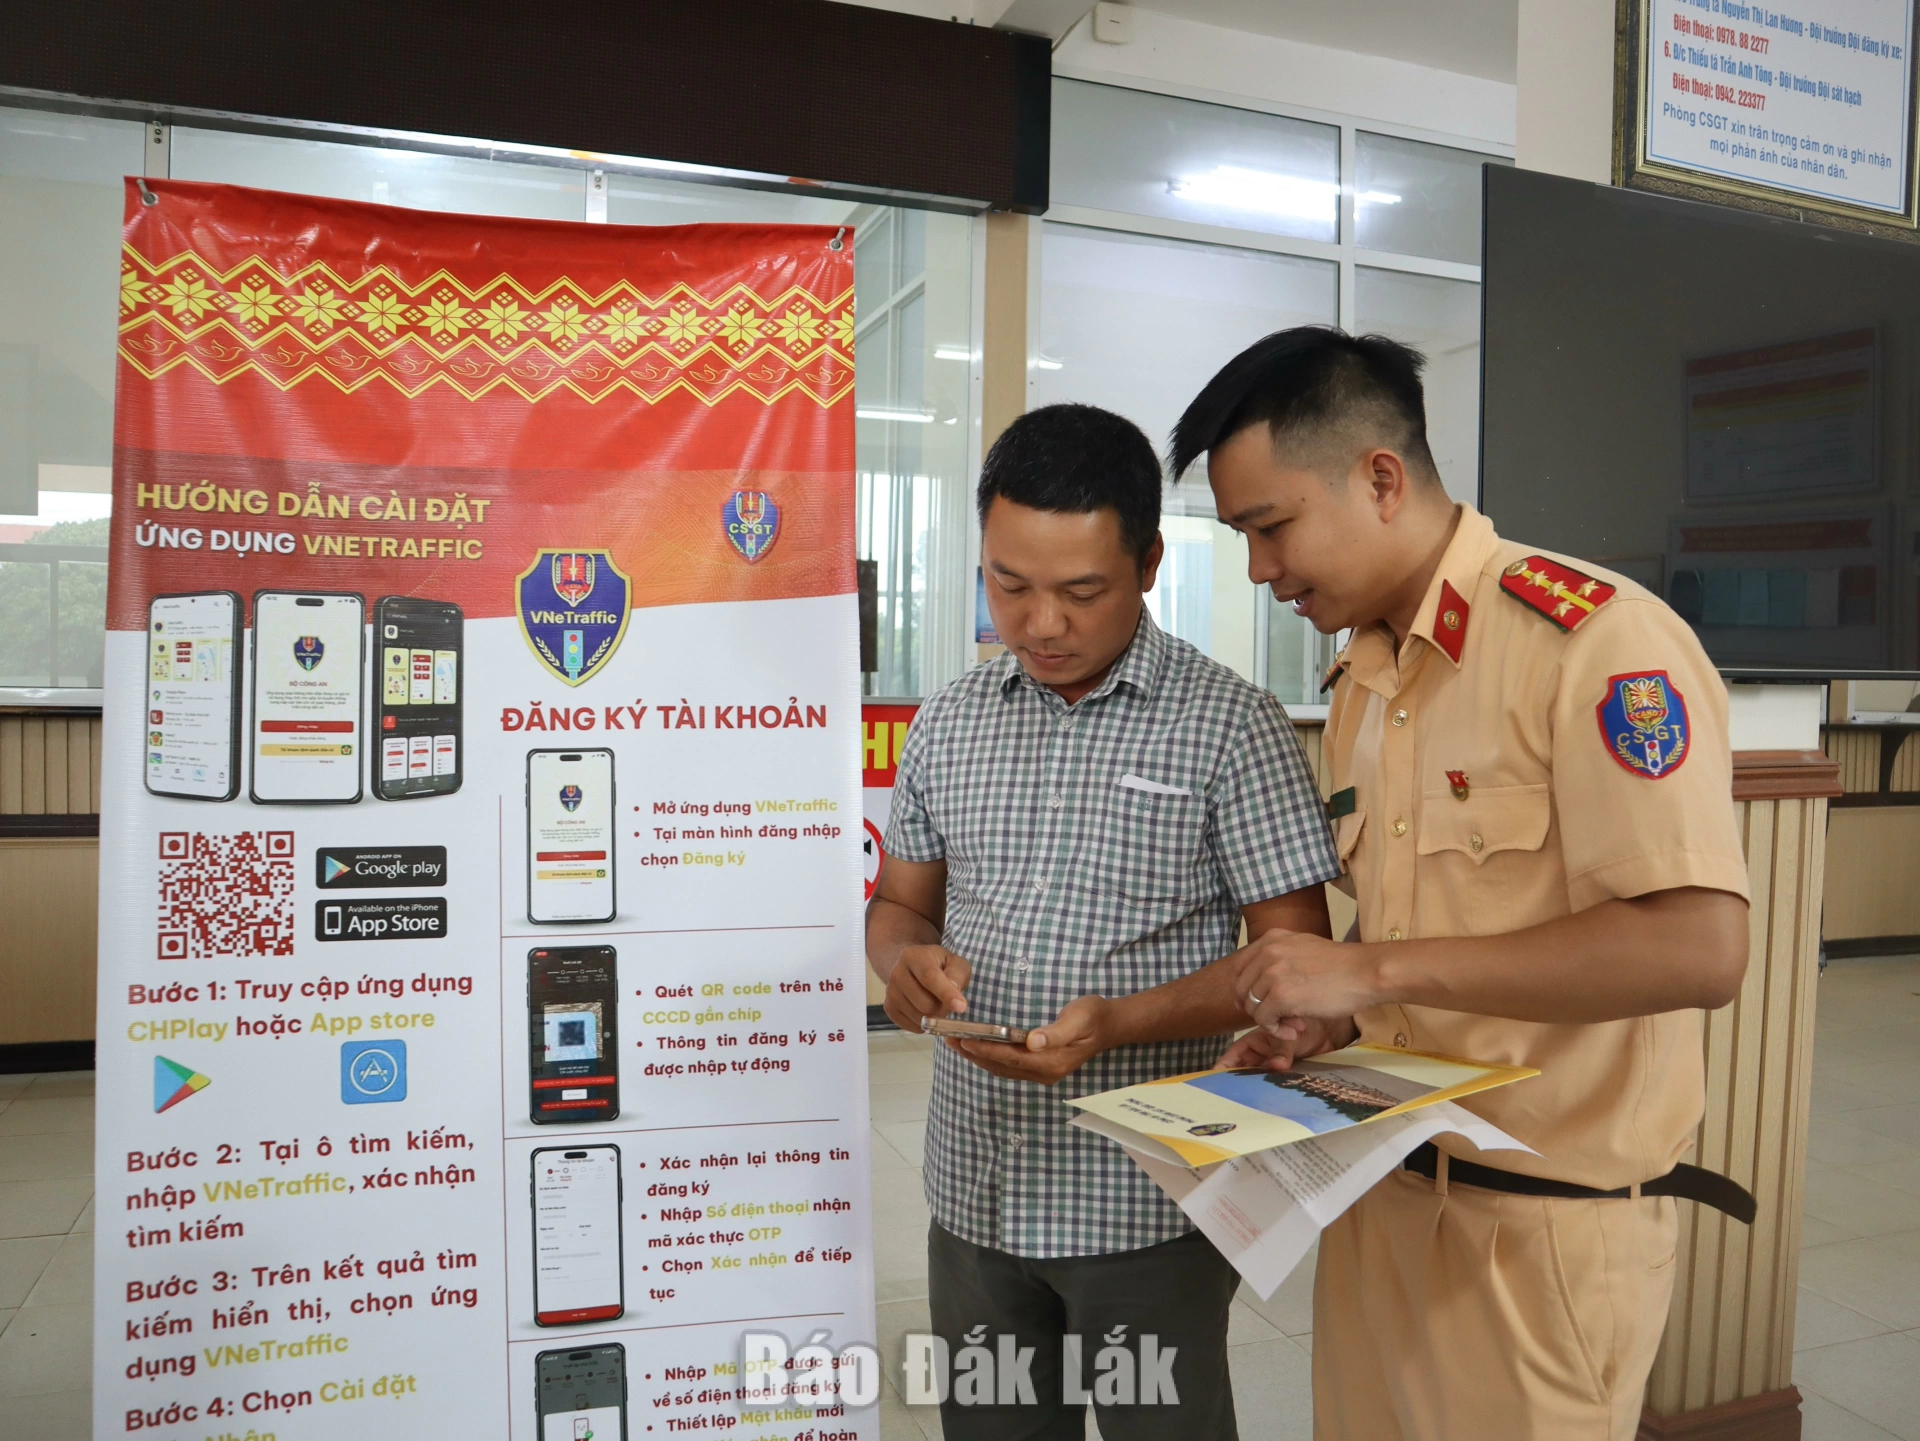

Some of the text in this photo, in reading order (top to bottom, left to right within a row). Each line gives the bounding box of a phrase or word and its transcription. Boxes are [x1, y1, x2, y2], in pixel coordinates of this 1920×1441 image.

[1674, 14, 1770, 54] Điện thoại: 0978. 88 2277
[1765, 10, 1860, 53] Lan Hương Đội trưởng Đội
[1674, 42, 1862, 108] Đ/c Thiếu Anh Đội trưởng Đội hạch
[1672, 72, 1766, 112] Điện thoại: 0942. 223377
[1663, 102, 1892, 169] Phòng CSGT xin trân trọng cảm và ghi nhận
[1710, 137, 1848, 180] mọi phản ánh của nhân dân.
[137, 480, 491, 530] HƯỚNG DẪN CÀI ĐẶT
[136, 519, 483, 560] ỨNG DỤNG VNETRAFFIC
[728, 522, 773, 536] CSGT
[530, 610, 618, 624] VNeTraffic
[500, 697, 827, 732] ĐĂNG KÝ TÀI KHOẢN
[1617, 726, 1682, 747] CSGT
[680, 799, 838, 816] ứng dụng VNeTraffic
[653, 822, 841, 842] Tại màn hình đăng nhập
[354, 860, 441, 878] Google play
[640, 851, 724, 867] chọn Đăng
[348, 904, 382, 914] Available
[395, 904, 410, 912] the
[411, 902, 439, 912] iPhone
[348, 914, 440, 936] App Store
[128, 972, 473, 1006] Bước Truy cập ứng dụng
[655, 978, 844, 1000] Quét QR code trên thẻ
[128, 1010, 436, 1042] CHPlay hoặc App store
[642, 1007, 762, 1026] CCCD gắn chíp
[656, 1031, 788, 1052] Thông đăng
[644, 1058, 790, 1077] được nhập động
[127, 1126, 474, 1172] Bước 2: Tại tìm kiếm,
[660, 1149, 820, 1170] Xác nhận thông
[126, 1164, 476, 1212] nhập VNeTraffic, xác nhận
[647, 1182, 688, 1198] đăng
[660, 1198, 851, 1223] Nhập điện thoại nhận
[126, 1215, 244, 1248] tìm kiếm
[648, 1227, 782, 1248] mã xác thực OTP
[662, 1246, 852, 1275] Chọn Xác nhận tiếp
[126, 1248, 477, 1302] Bước 3: Trên kết quả tìm
[650, 1286, 676, 1302] tục
[126, 1284, 478, 1340] kiếm hiển thị, chọn ứng
[126, 1333, 349, 1382] dụng VNeTraffic
[665, 1360, 738, 1382] Nhập Mã
[125, 1374, 417, 1431] Bước 4: Chọn Cài đặt
[698, 1388, 732, 1404] điện
[666, 1404, 844, 1432] Thiết lập Mật mới
